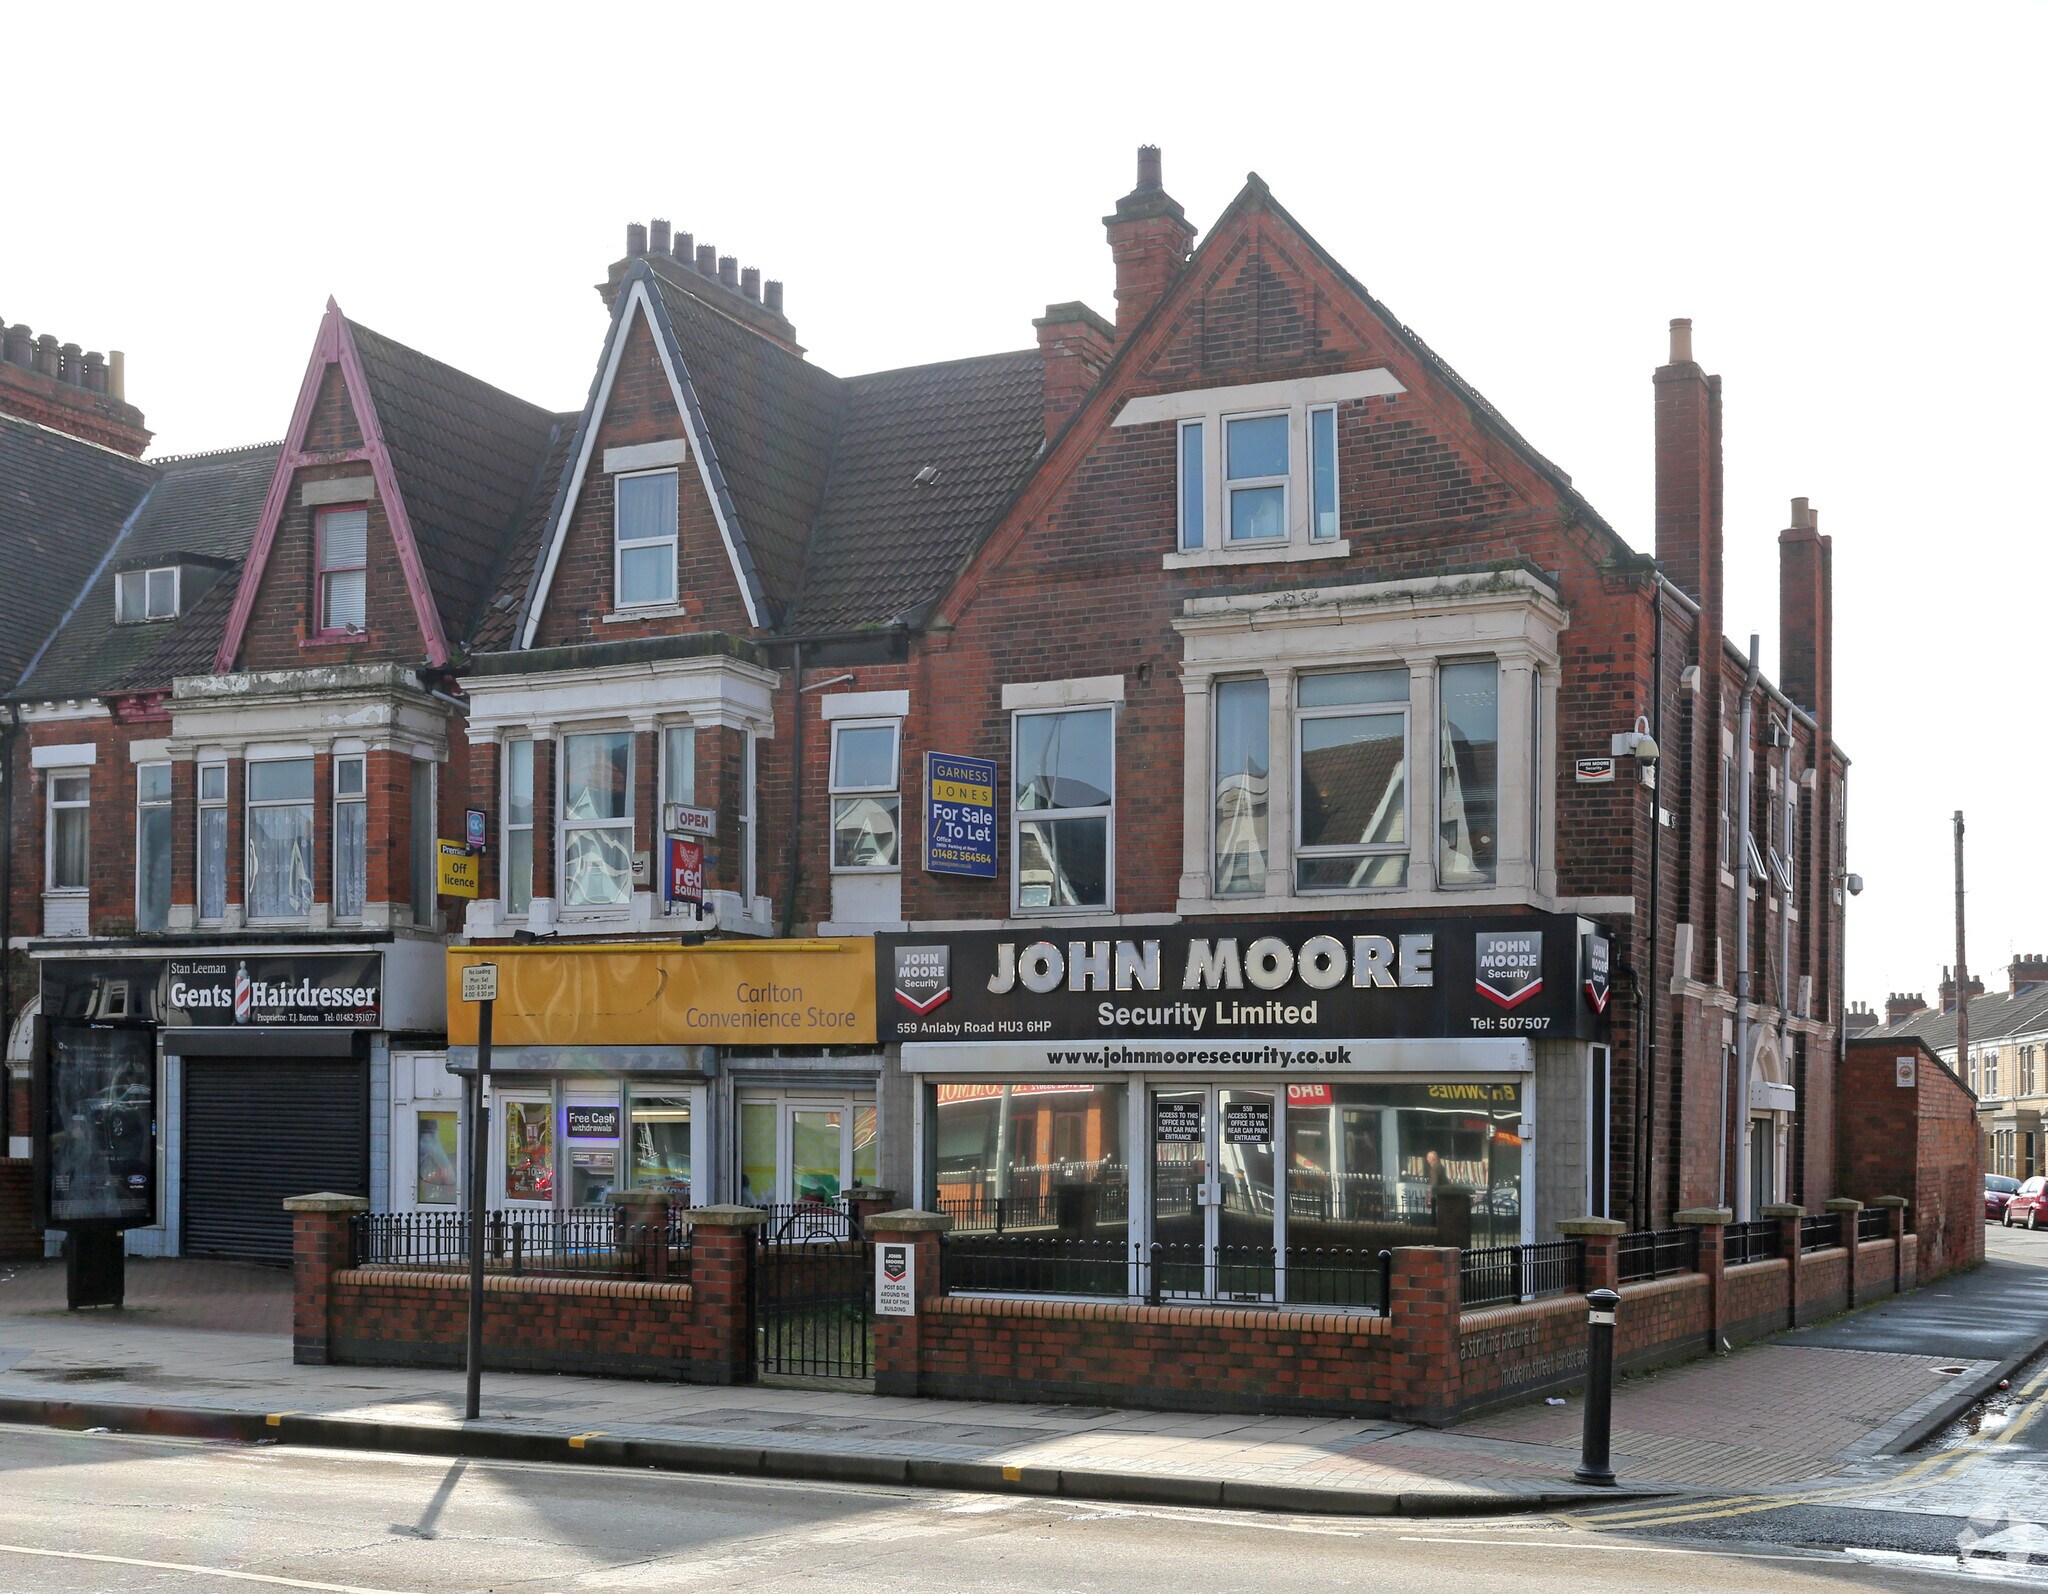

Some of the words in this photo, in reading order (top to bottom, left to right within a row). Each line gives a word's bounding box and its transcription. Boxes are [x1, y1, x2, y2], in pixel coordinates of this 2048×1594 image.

[937, 766, 988, 782] GARNESS
[938, 786, 988, 801] JONES
[680, 812, 708, 828] OPEN
[933, 804, 958, 821] For
[962, 807, 992, 824] Sale
[946, 822, 963, 838] To
[968, 825, 991, 842] Let
[442, 846, 466, 856] Premier
[932, 848, 958, 860] 01482
[960, 852, 991, 864] 564564
[452, 862, 467, 874] Off
[444, 874, 474, 887] licence
[676, 864, 702, 889] red
[1488, 940, 1530, 952] JOHN
[904, 954, 938, 964] JOHN
[987, 939, 1161, 994] JOHN
[1182, 934, 1434, 990] MOORE
[1480, 954, 1536, 967] MOORE
[171, 962, 190, 974] Stan
[192, 963, 226, 974] Leeman
[898, 966, 944, 978] MOORE
[1488, 969, 1530, 979] Security
[904, 979, 938, 988] Security
[171, 982, 232, 1007] Gents
[252, 978, 376, 1007] Hairdresser
[737, 982, 803, 1002] Carlton
[257, 1014, 288, 1024] Proprietor:
[299, 1014, 318, 1022] Burton
[324, 1014, 334, 1022] Tel:
[336, 1014, 354, 1022] 01482
[356, 1014, 376, 1022] 351077
[686, 1008, 801, 1028] Convenience
[807, 1007, 856, 1028] Store
[1098, 1002, 1206, 1031] Security
[1216, 1001, 1318, 1026] Limited
[897, 1023, 917, 1034] 559
[920, 1022, 960, 1035] Anlaby
[964, 1022, 996, 1033] Road
[998, 1022, 1023, 1032] HU3
[1026, 1021, 1052, 1032] 6HP
[1470, 1018, 1494, 1030] Tel:
[1499, 1018, 1550, 1029] 507507
[1047, 1046, 1352, 1068] www.johnmooresecurity.co.uk
[569, 1113, 590, 1123] Free
[592, 1113, 615, 1123] Cash
[572, 1124, 612, 1132] withdrawals
[1460, 1342, 1466, 1360] a
[1468, 1332, 1499, 1358] striking
[1501, 1328, 1529, 1356] picture
[1531, 1320, 1540, 1343] of
[1501, 1363, 1530, 1386] modern
[1532, 1356, 1555, 1378] street
[1556, 1347, 1588, 1372] landscape
